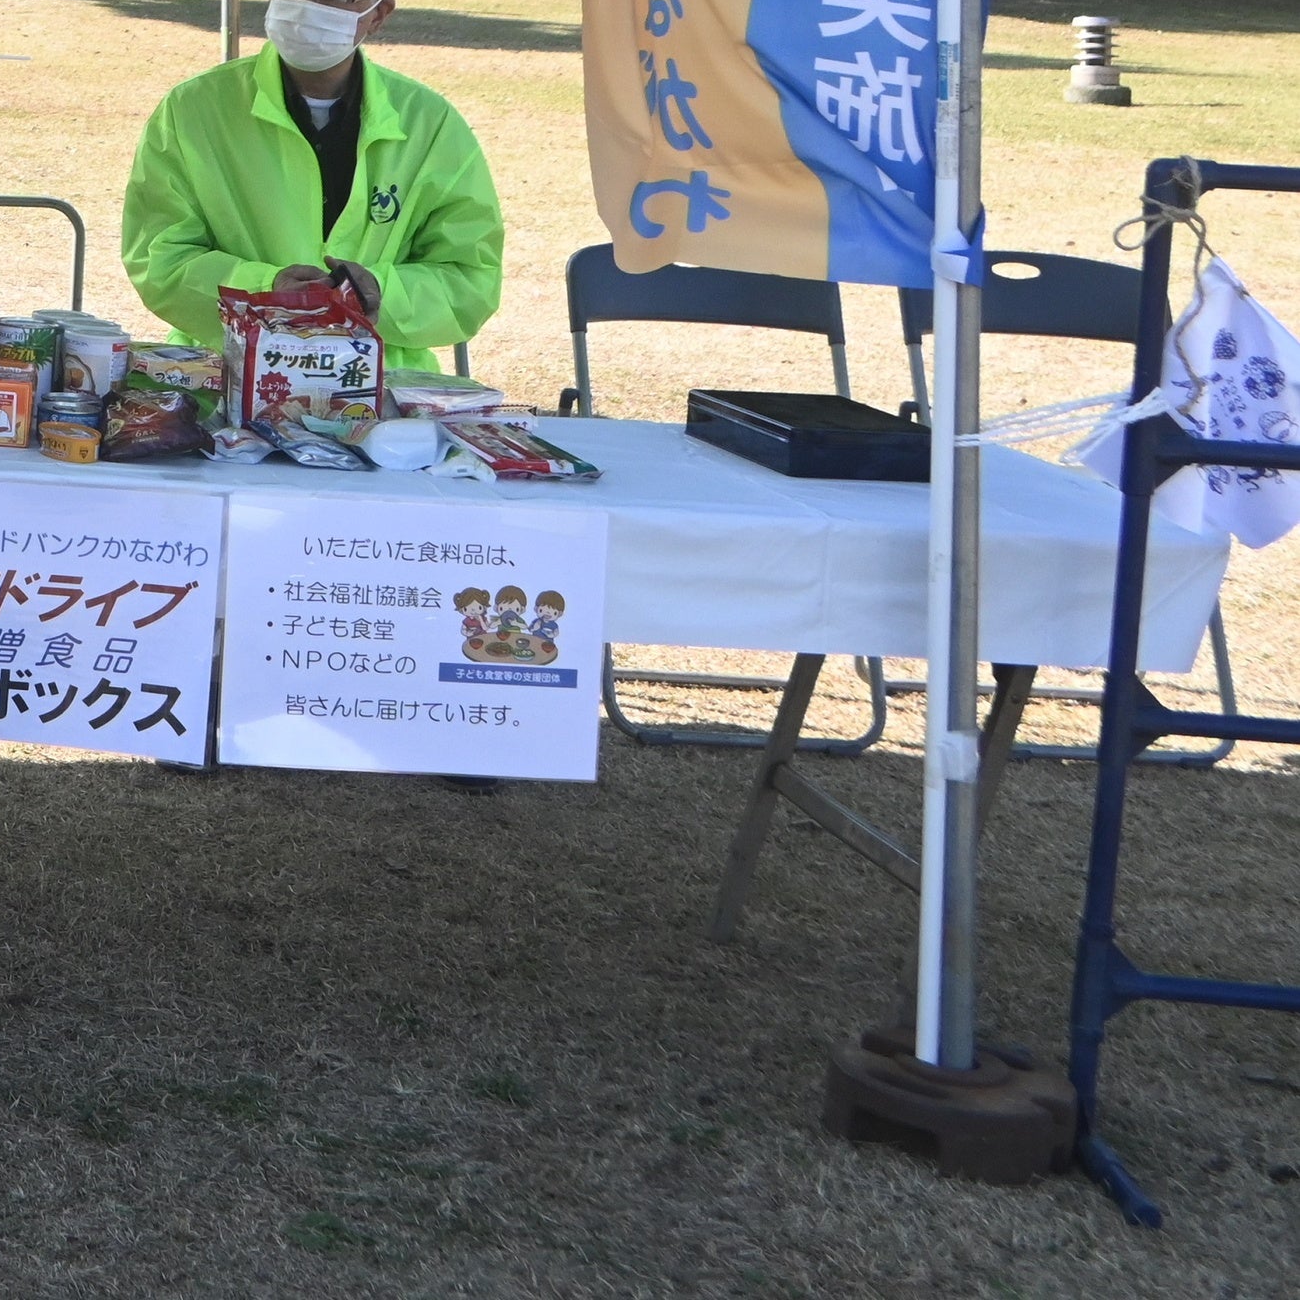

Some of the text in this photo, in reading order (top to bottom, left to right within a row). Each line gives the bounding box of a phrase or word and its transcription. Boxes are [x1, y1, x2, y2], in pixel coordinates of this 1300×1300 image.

[302, 536, 516, 567] いただいた食料品は、
[285, 695, 521, 728] 皆さんに届けています。
